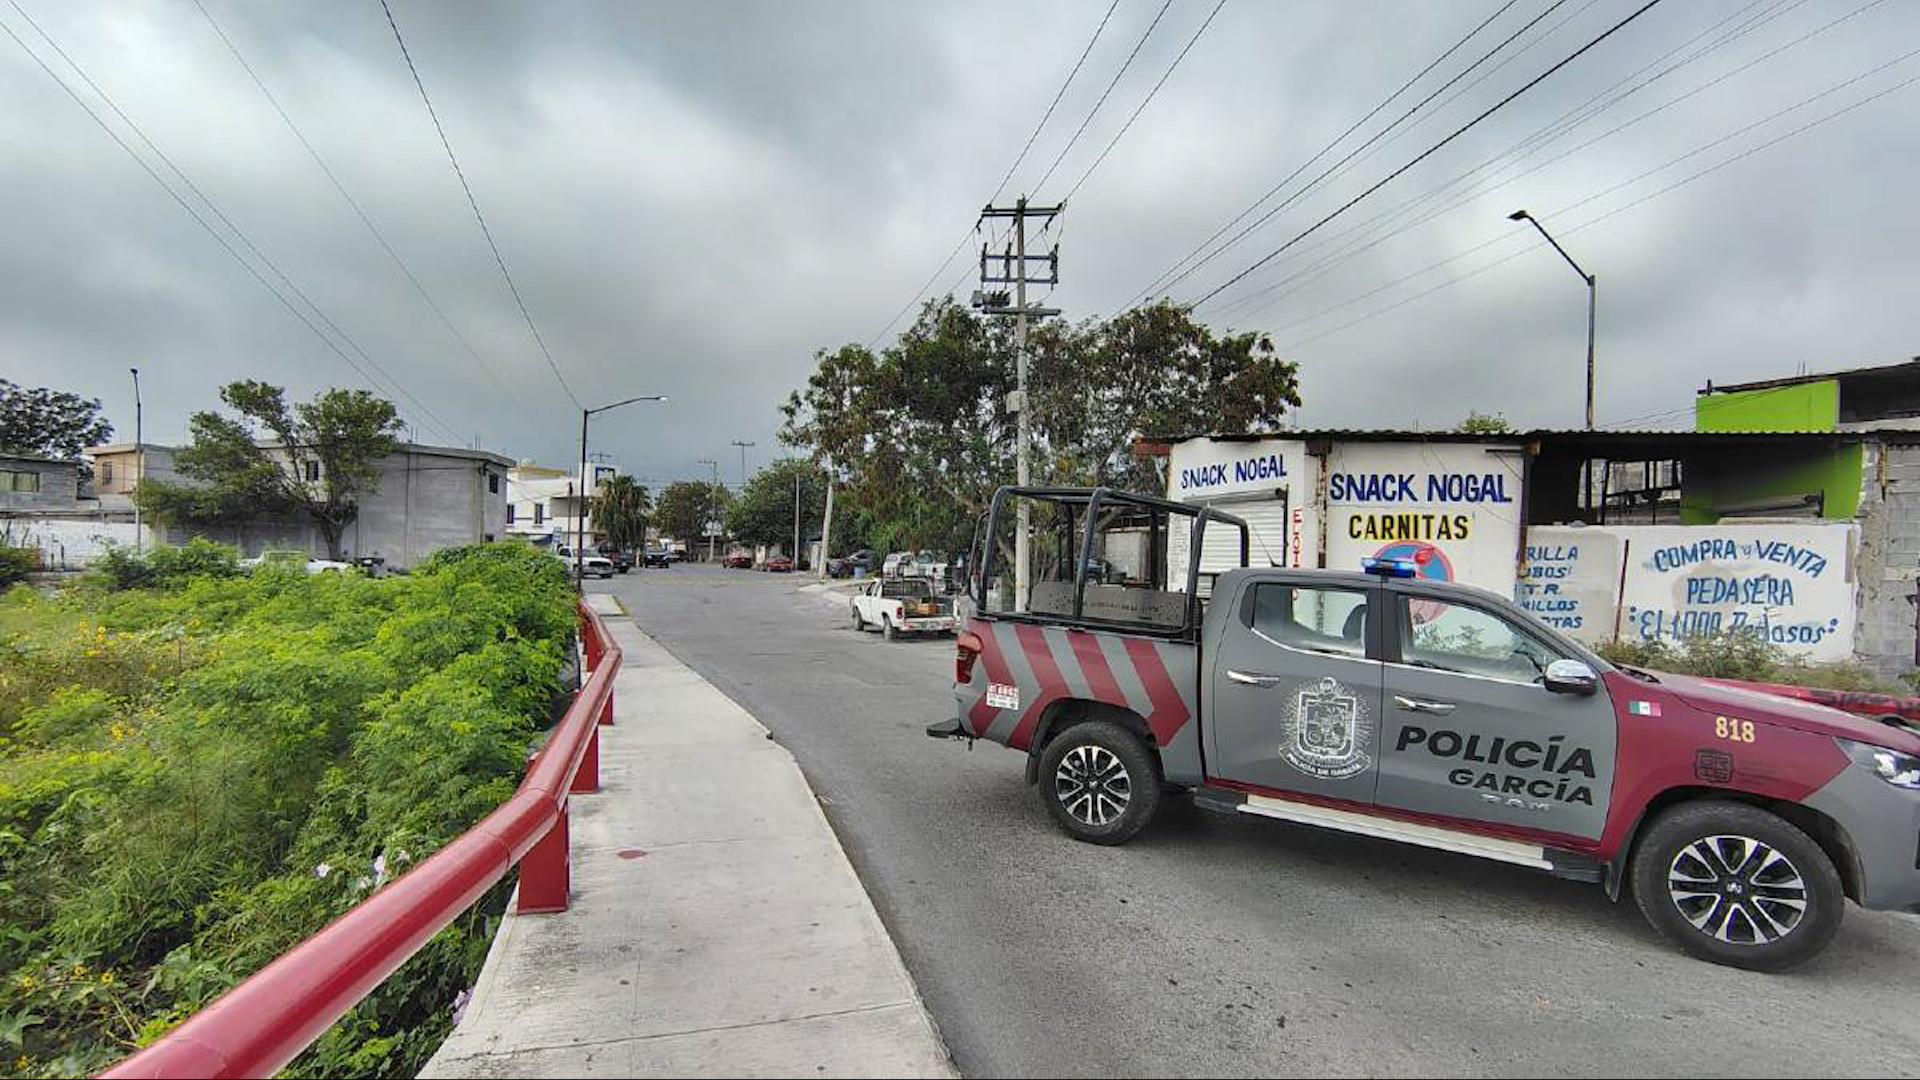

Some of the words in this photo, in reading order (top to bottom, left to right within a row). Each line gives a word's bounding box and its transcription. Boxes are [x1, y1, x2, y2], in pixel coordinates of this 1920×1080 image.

[1181, 463, 1228, 489] SNACK
[1235, 453, 1287, 483] NOGAL
[1330, 473, 1418, 502] SNACK
[1427, 474, 1513, 503] NOGAL
[1349, 514, 1469, 540] CARNITAS
[1654, 539, 1737, 573] COMPRA
[1755, 539, 1828, 578] VENTA
[1687, 576, 1794, 606] PEDASERA
[1715, 716, 1755, 743] 818
[1396, 725, 1596, 780] POLICÍA
[1448, 768, 1593, 806] GARCÍA
